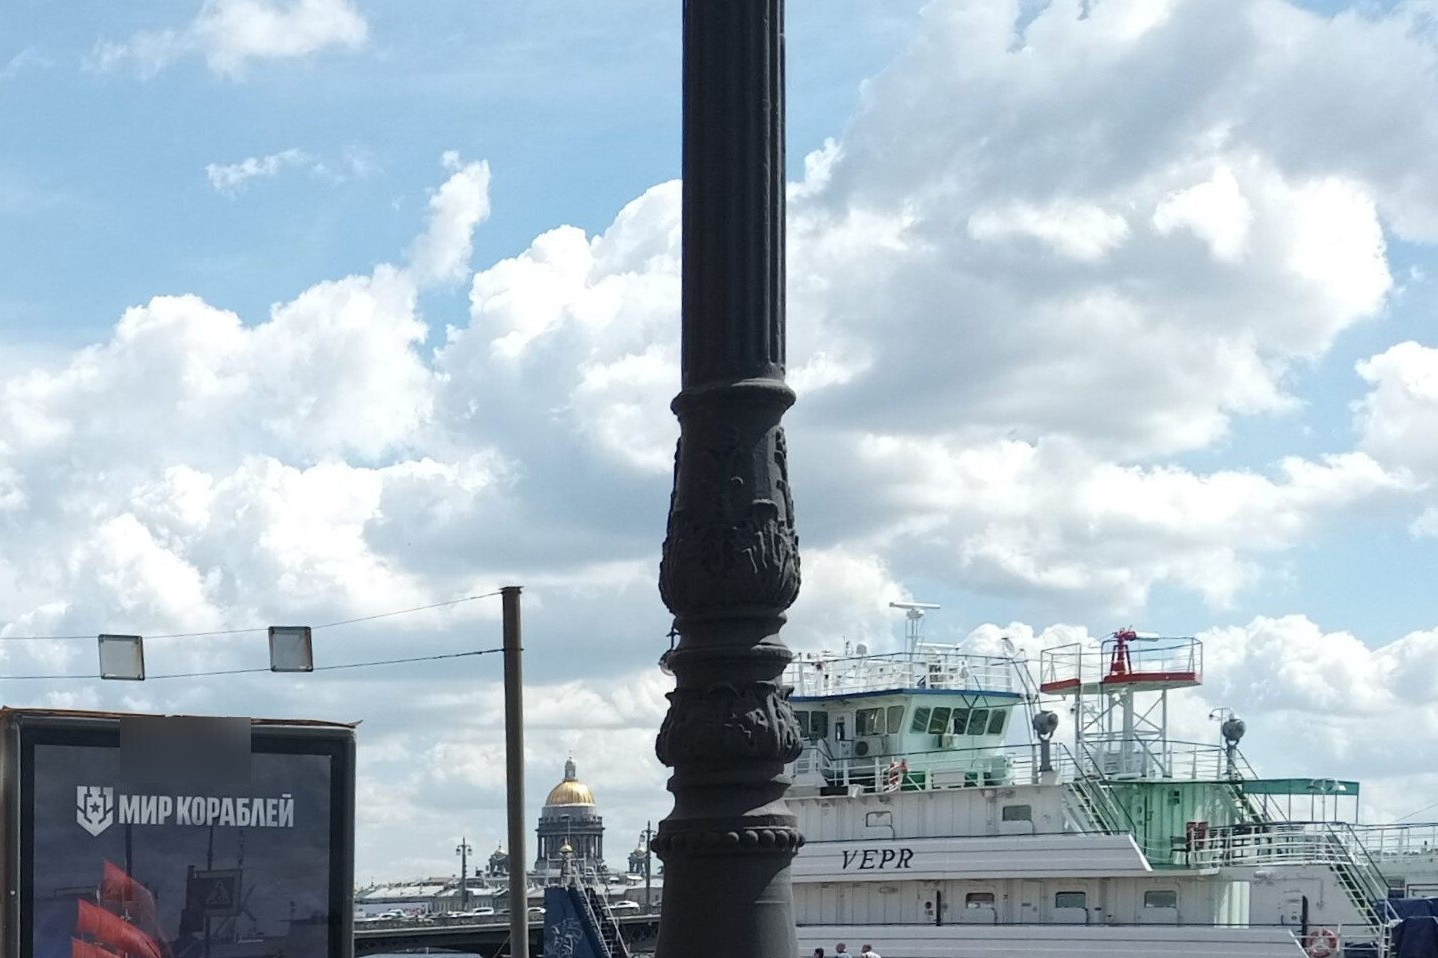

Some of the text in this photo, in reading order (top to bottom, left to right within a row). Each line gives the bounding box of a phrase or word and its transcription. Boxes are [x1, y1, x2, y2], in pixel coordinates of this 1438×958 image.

[118, 793, 294, 827] МИР КОРАБЛЕЙ
[842, 848, 914, 870] VEPR
